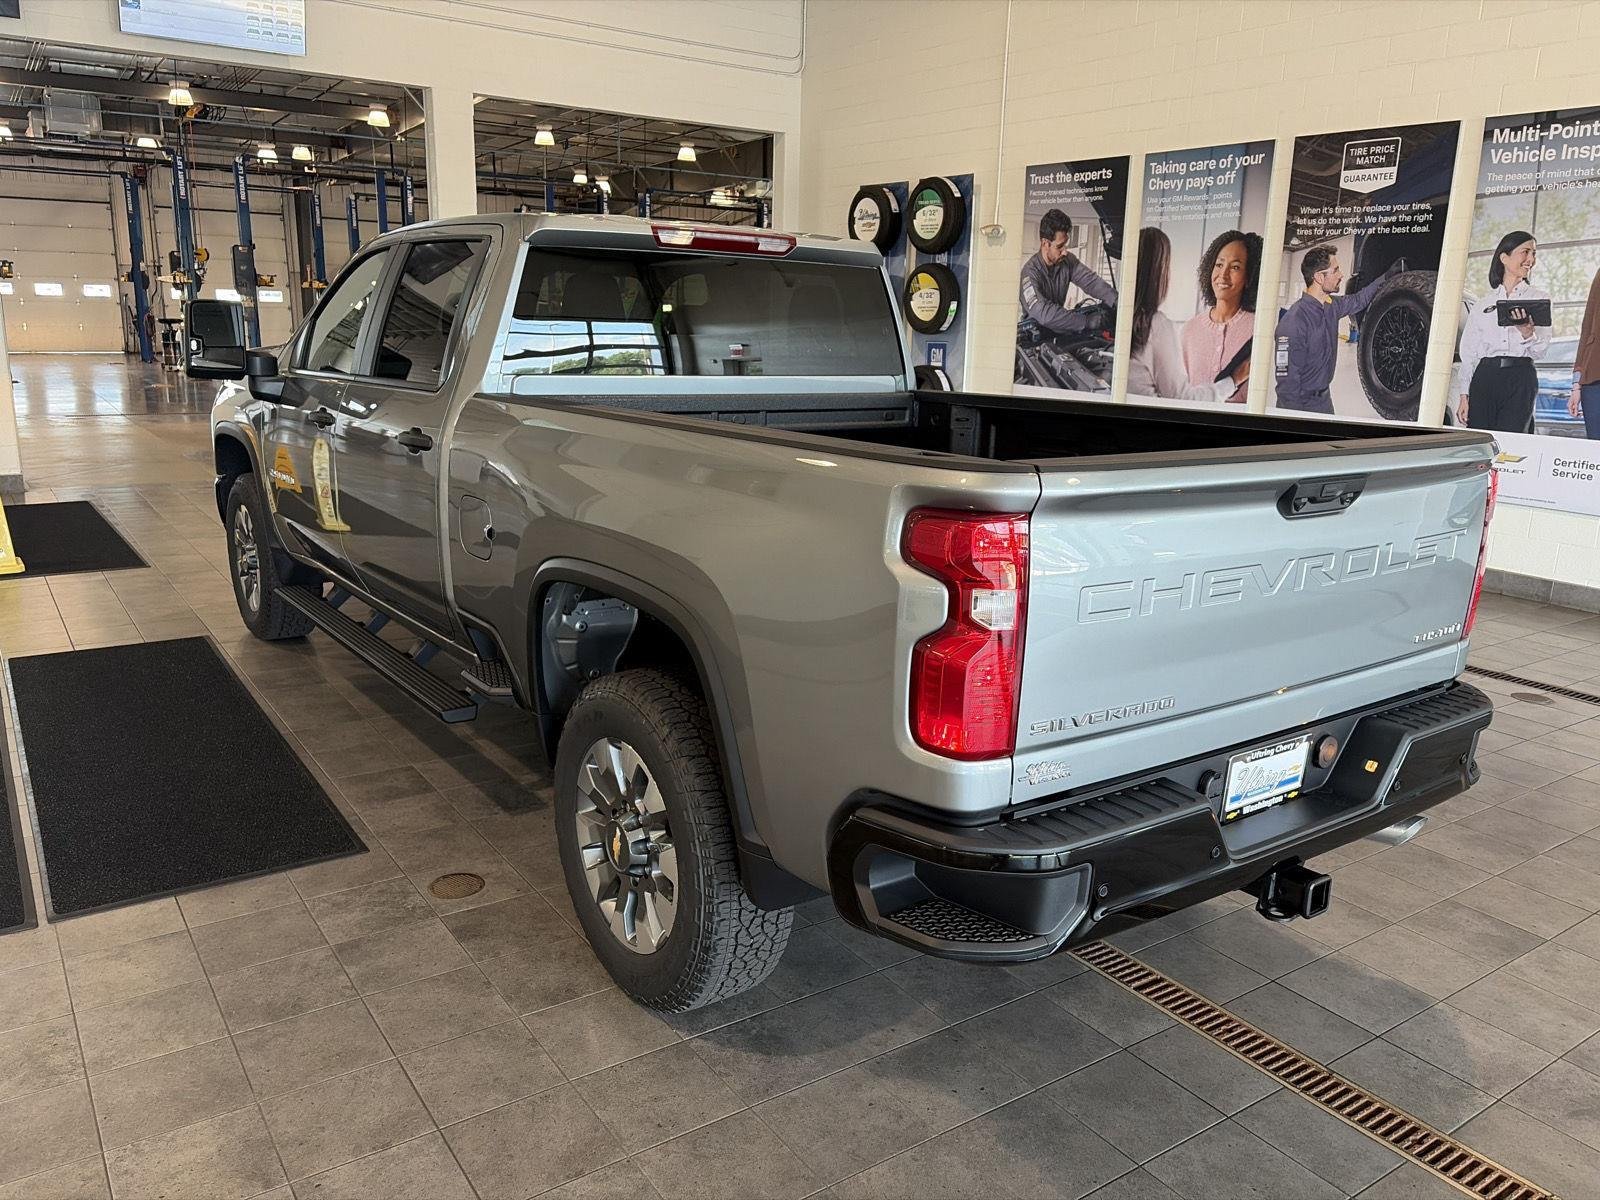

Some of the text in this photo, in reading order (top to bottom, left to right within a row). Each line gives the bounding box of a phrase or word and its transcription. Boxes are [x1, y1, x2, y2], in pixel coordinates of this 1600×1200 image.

[1493, 120, 1600, 143] Multi-Point
[1350, 145, 1395, 156] TIRE PRICE
[1490, 144, 1600, 164] Vehicle Insp
[1150, 153, 1265, 175] Taking care of your
[1356, 155, 1386, 165] MATCH
[1030, 168, 1112, 184] Trust the experts
[1149, 171, 1236, 191] Chevy pays off
[1344, 172, 1394, 183] GUARANTEE
[1488, 173, 1503, 181] The
[1505, 173, 1533, 182] peace
[1535, 170, 1545, 179] of
[1547, 168, 1572, 178] mind
[1574, 167, 1594, 177] that
[178, 170, 186, 197] ROTARY
[1485, 184, 1517, 195] getting
[1520, 184, 1540, 194] your
[1543, 180, 1583, 191] vehicle's
[1213, 192, 1232, 200] points
[1300, 206, 1320, 214] When
[1322, 206, 1333, 214] it's
[1335, 205, 1351, 213] time
[1363, 204, 1391, 213] replace
[1392, 203, 1410, 212] your
[1412, 202, 1432, 210] tires,
[1297, 216, 1306, 224] let
[1318, 216, 1327, 224] do
[1329, 216, 1340, 224] the
[1342, 216, 1362, 224] work.
[1378, 215, 1396, 223] have
[1399, 214, 1411, 222] the
[1413, 213, 1432, 222] right
[1314, 227, 1324, 235] for
[1325, 228, 1342, 236] your
[1343, 226, 1365, 235] Chevy
[1378, 226, 1390, 234] the
[1392, 225, 1409, 233] best
[1411, 224, 1430, 233] deal.
[931, 348, 943, 362] GM
[1552, 469, 1593, 480] Service
[1078, 529, 1467, 623] CHEVROLET
[1030, 696, 1175, 735] SILVERADO
[1251, 742, 1295, 760] Uftring Chevy
[1243, 795, 1284, 814] Washington
